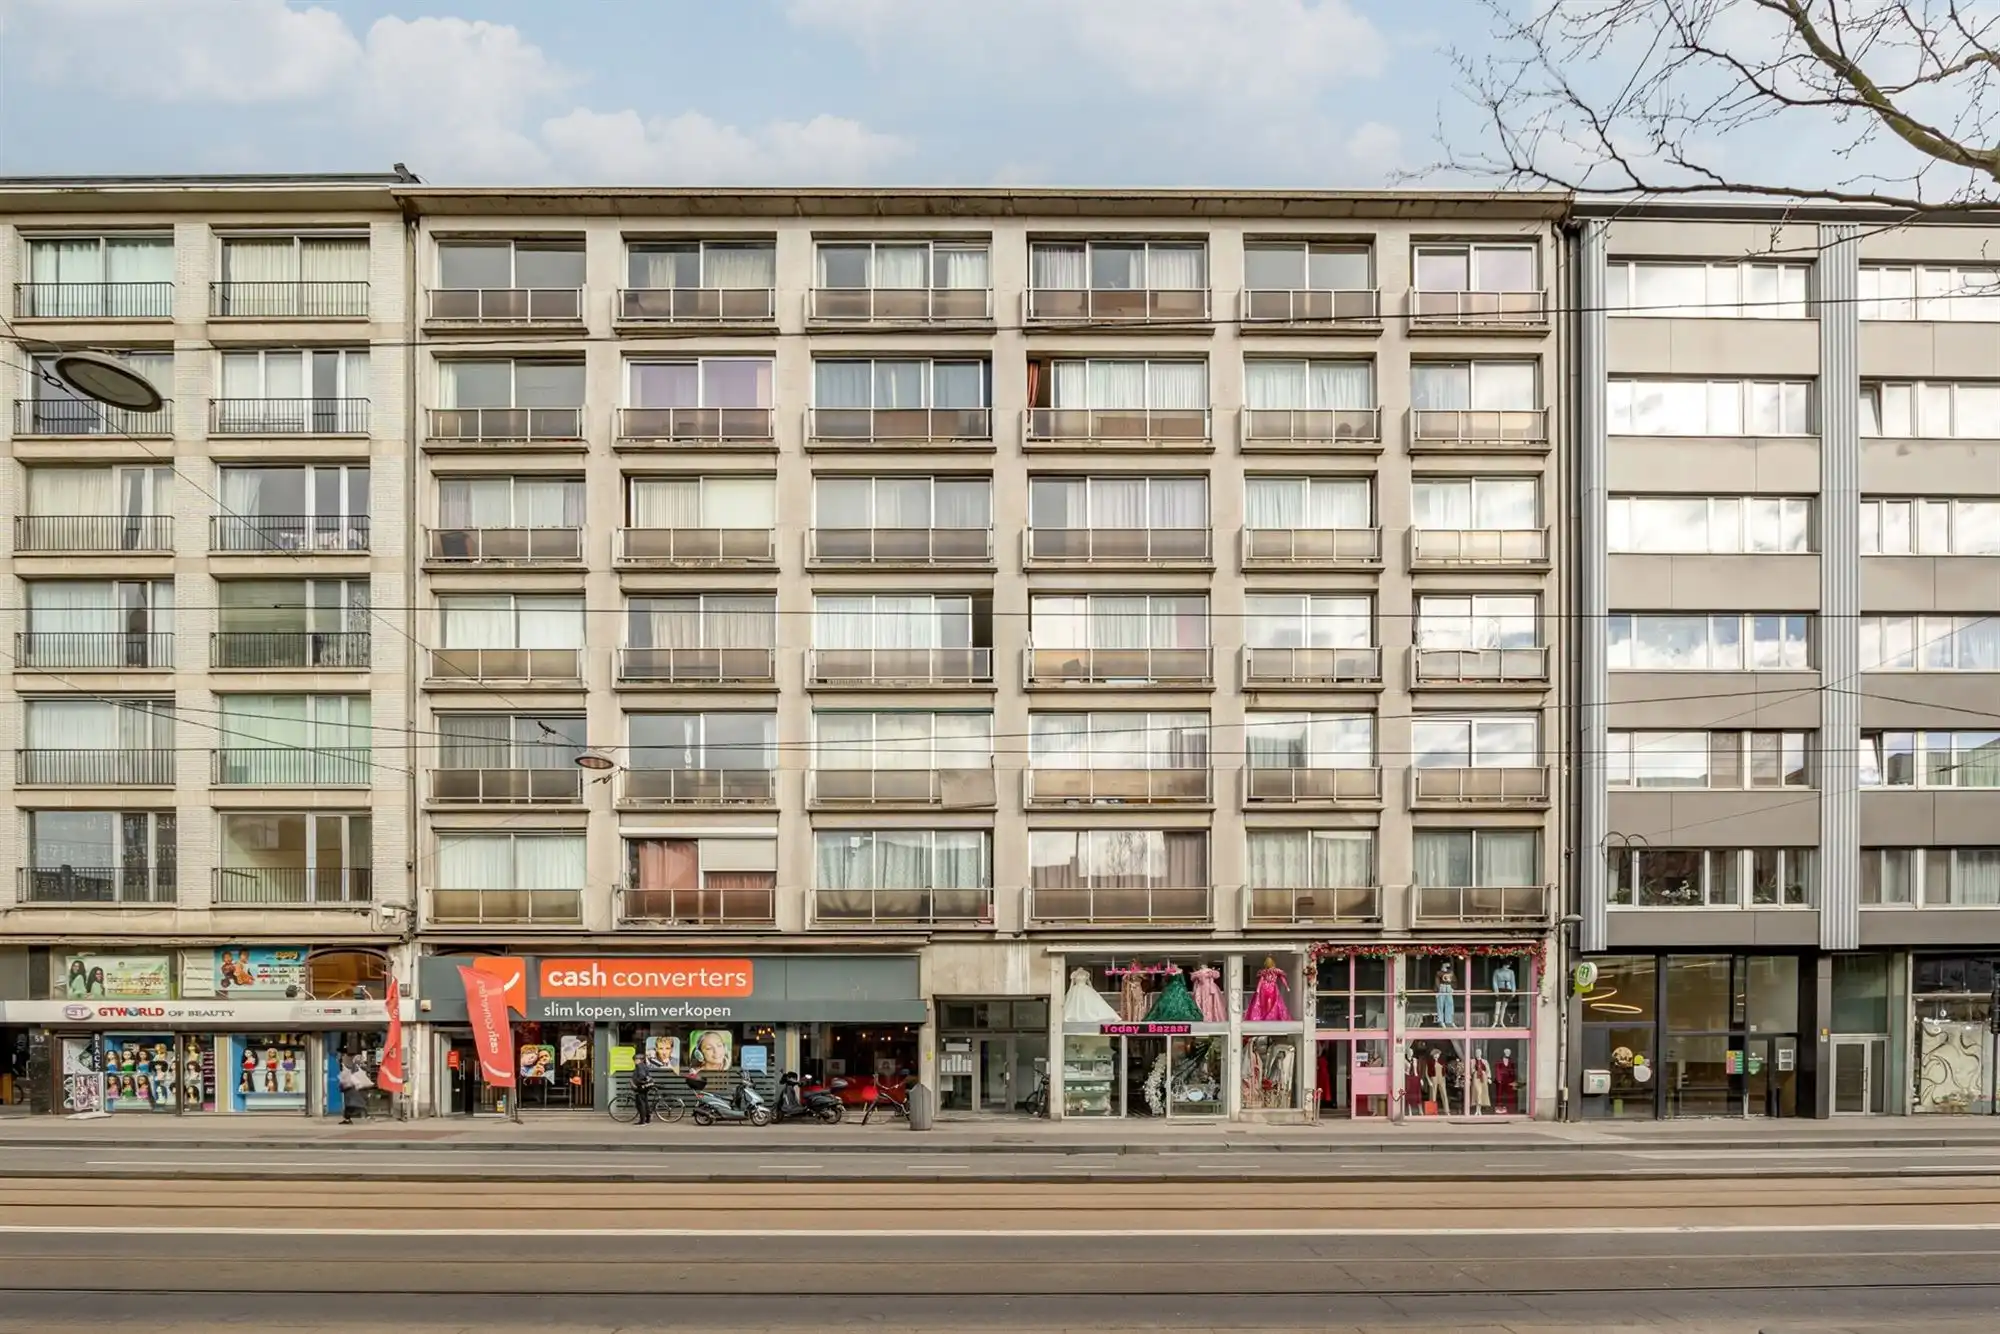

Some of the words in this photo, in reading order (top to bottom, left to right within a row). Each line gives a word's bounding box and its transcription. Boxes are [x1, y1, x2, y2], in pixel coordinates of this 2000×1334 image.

[549, 963, 607, 987] cash
[612, 968, 747, 987] converters
[544, 1002, 573, 1017] slim
[576, 1001, 626, 1019] kopen,
[628, 1002, 658, 1017] slim
[661, 1001, 731, 1019] verkopen
[1103, 1024, 1140, 1034] Today
[1148, 1024, 1189, 1033] Bazaar
